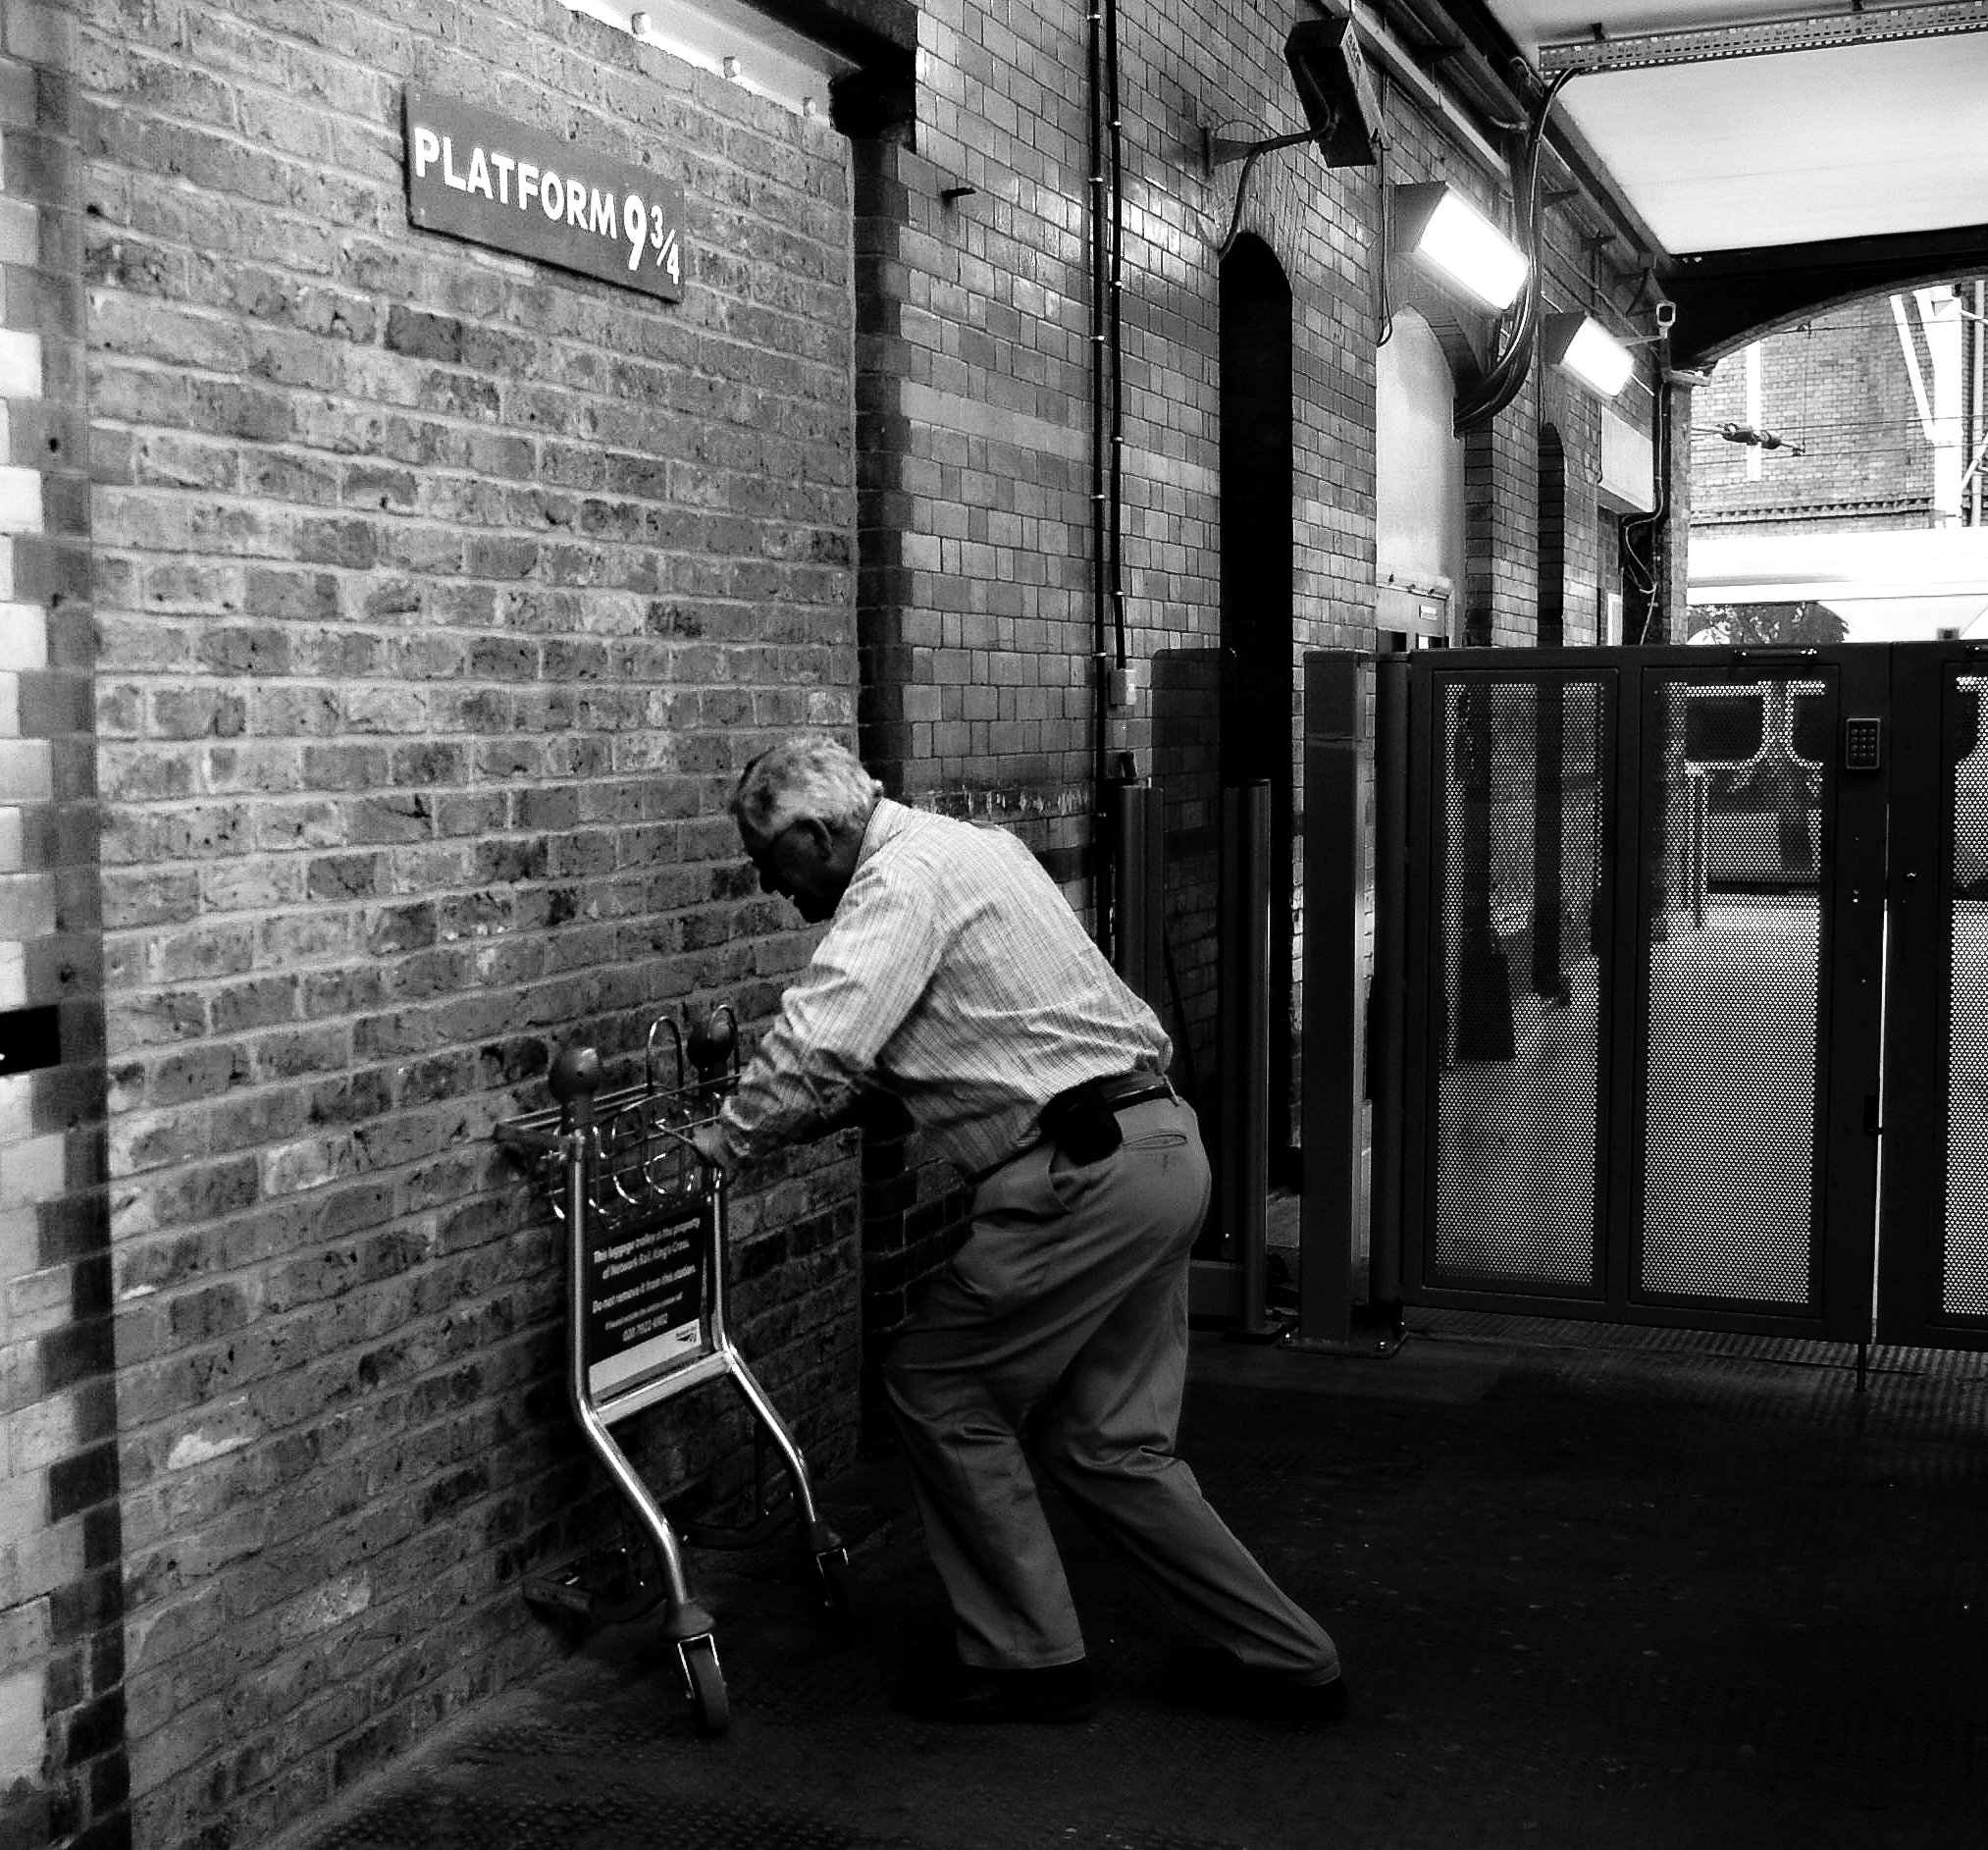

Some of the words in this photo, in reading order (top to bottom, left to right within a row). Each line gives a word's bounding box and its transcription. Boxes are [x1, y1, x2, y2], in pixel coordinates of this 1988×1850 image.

[414, 127, 618, 239] PLATFORM
[607, 1241, 634, 1258] luggage
[673, 1218, 700, 1236] property
